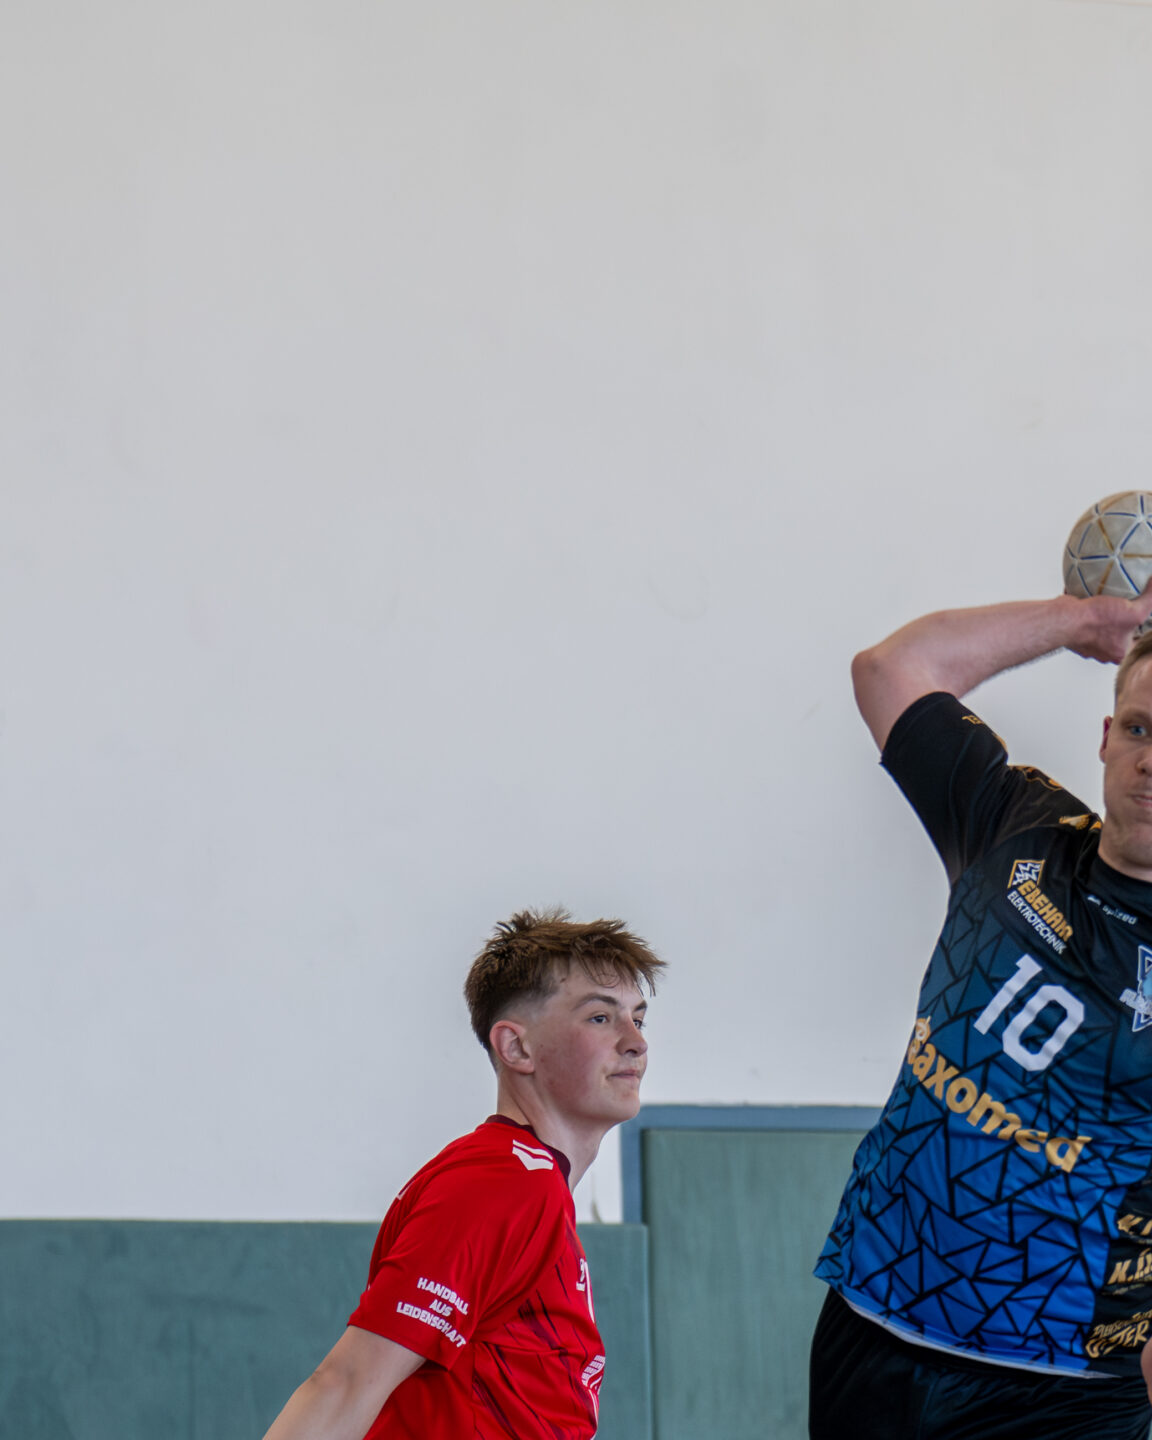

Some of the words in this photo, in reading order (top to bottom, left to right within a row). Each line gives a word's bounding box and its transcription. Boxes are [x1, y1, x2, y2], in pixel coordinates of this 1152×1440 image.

[1007, 890, 1067, 955] ELEKTROTECHNIK
[973, 954, 1085, 1072] 10
[416, 1277, 469, 1315] HANDBALL
[428, 1299, 454, 1317] AUS
[396, 1301, 466, 1348] LEIDENSCHAFT
